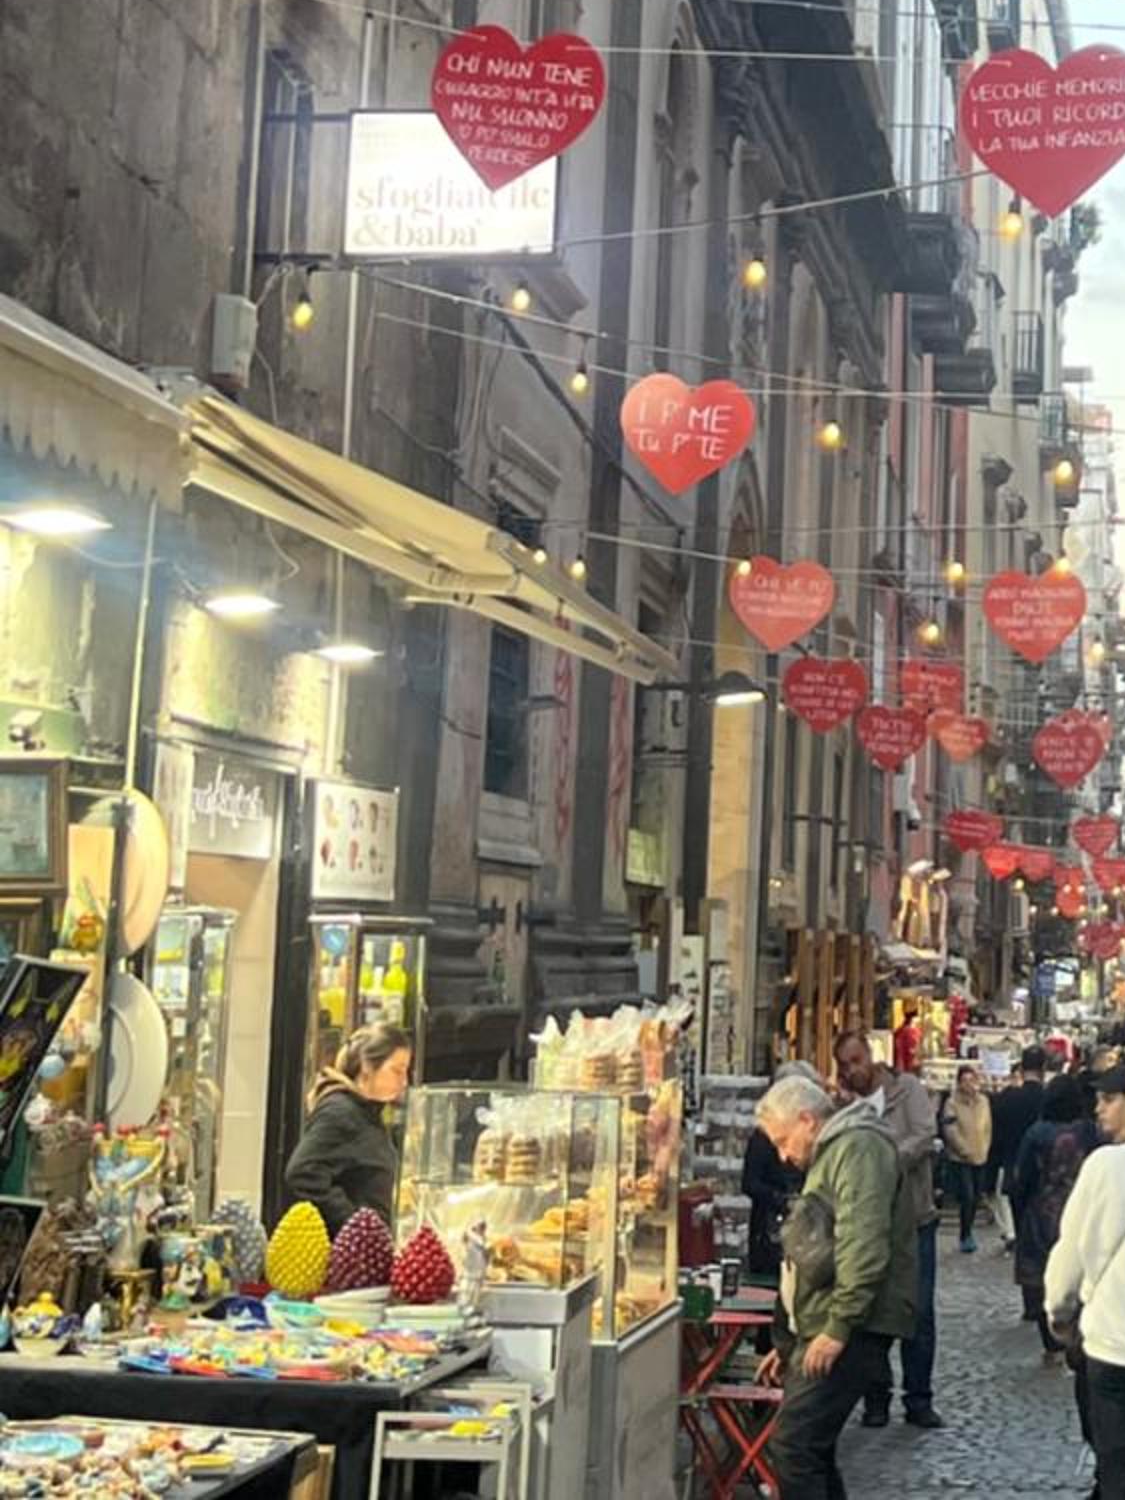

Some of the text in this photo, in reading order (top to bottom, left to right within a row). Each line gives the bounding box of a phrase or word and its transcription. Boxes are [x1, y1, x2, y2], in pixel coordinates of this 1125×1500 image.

[541, 63, 592, 86] TENE
[979, 135, 1003, 152] LA
[687, 405, 733, 434] ME
[696, 435, 725, 460] TE
